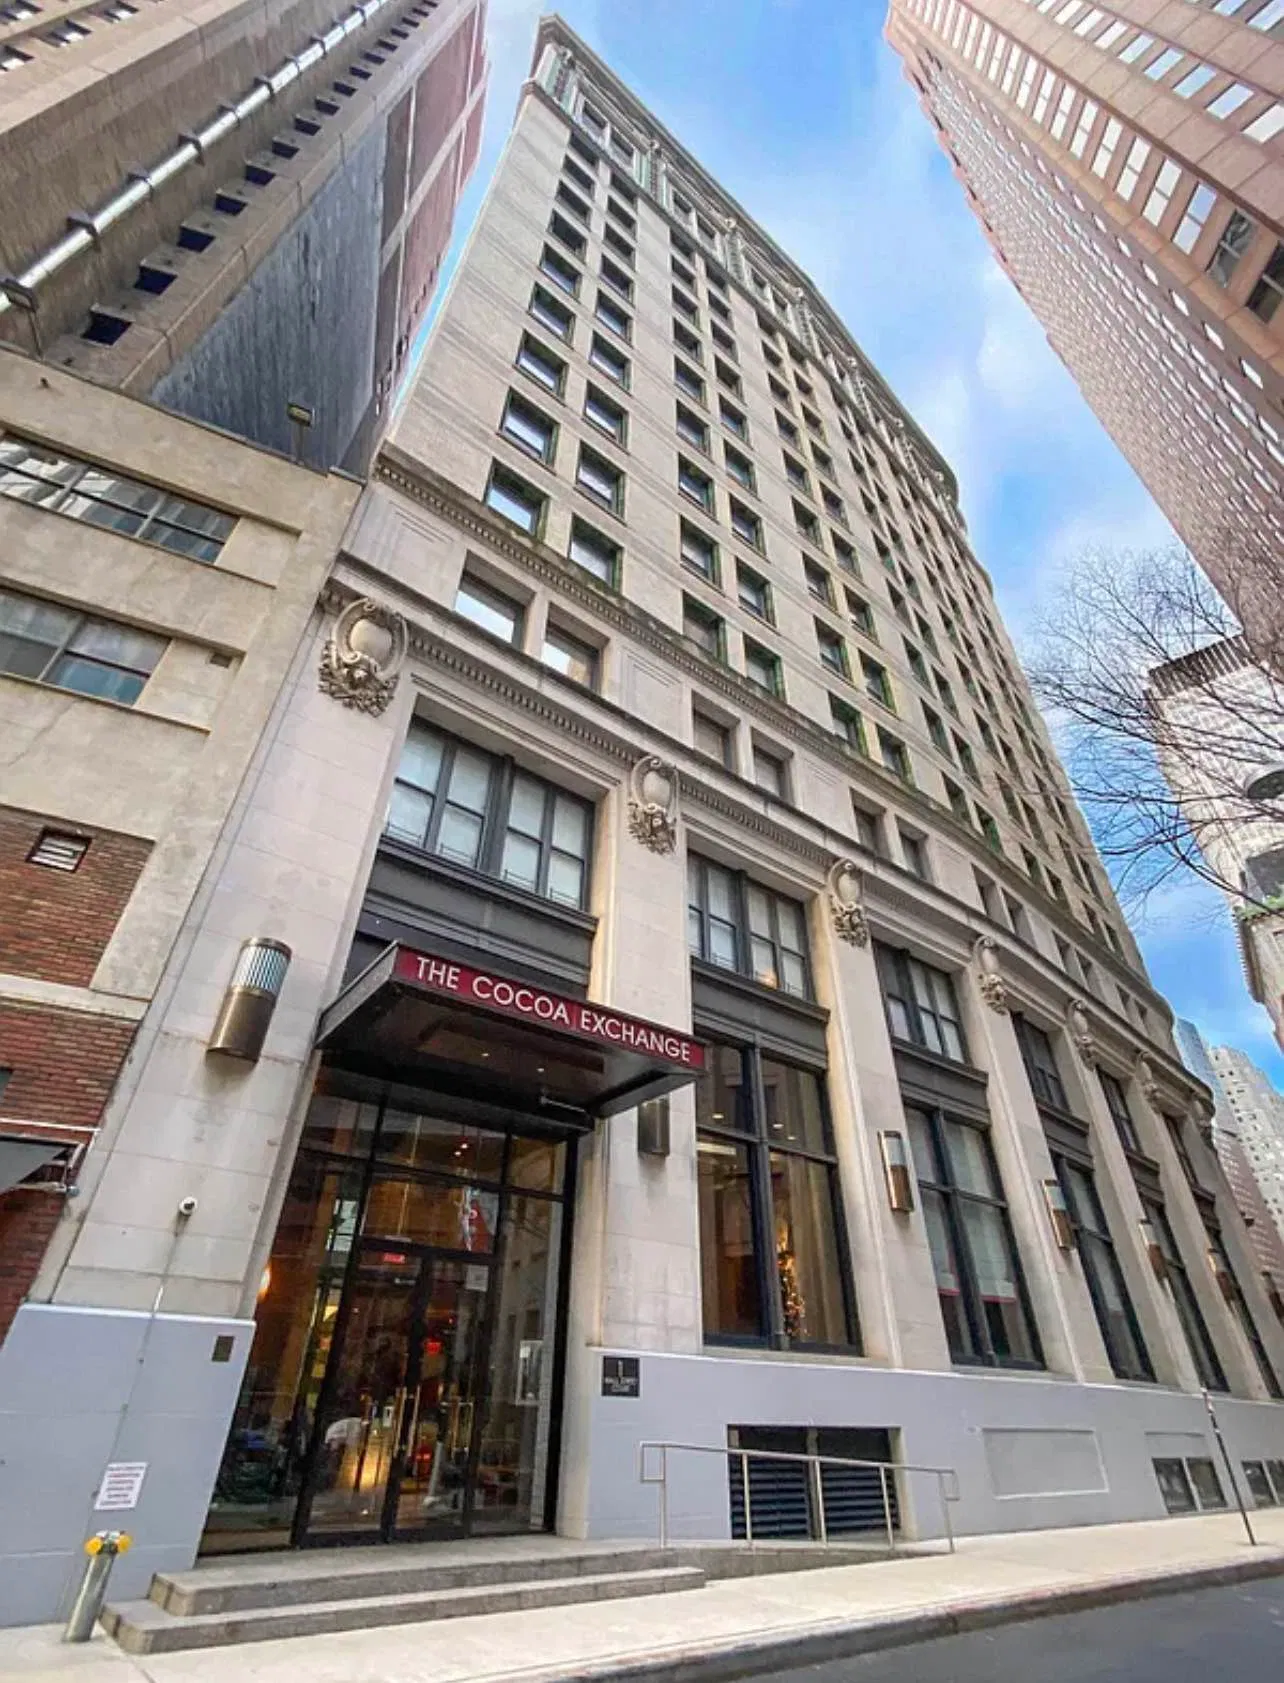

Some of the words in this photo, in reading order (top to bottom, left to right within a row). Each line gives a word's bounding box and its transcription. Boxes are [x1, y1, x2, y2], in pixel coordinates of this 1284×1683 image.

[416, 957, 461, 989] THE
[472, 976, 570, 1025] COCOA
[580, 1011, 691, 1062] EXCHANGE
